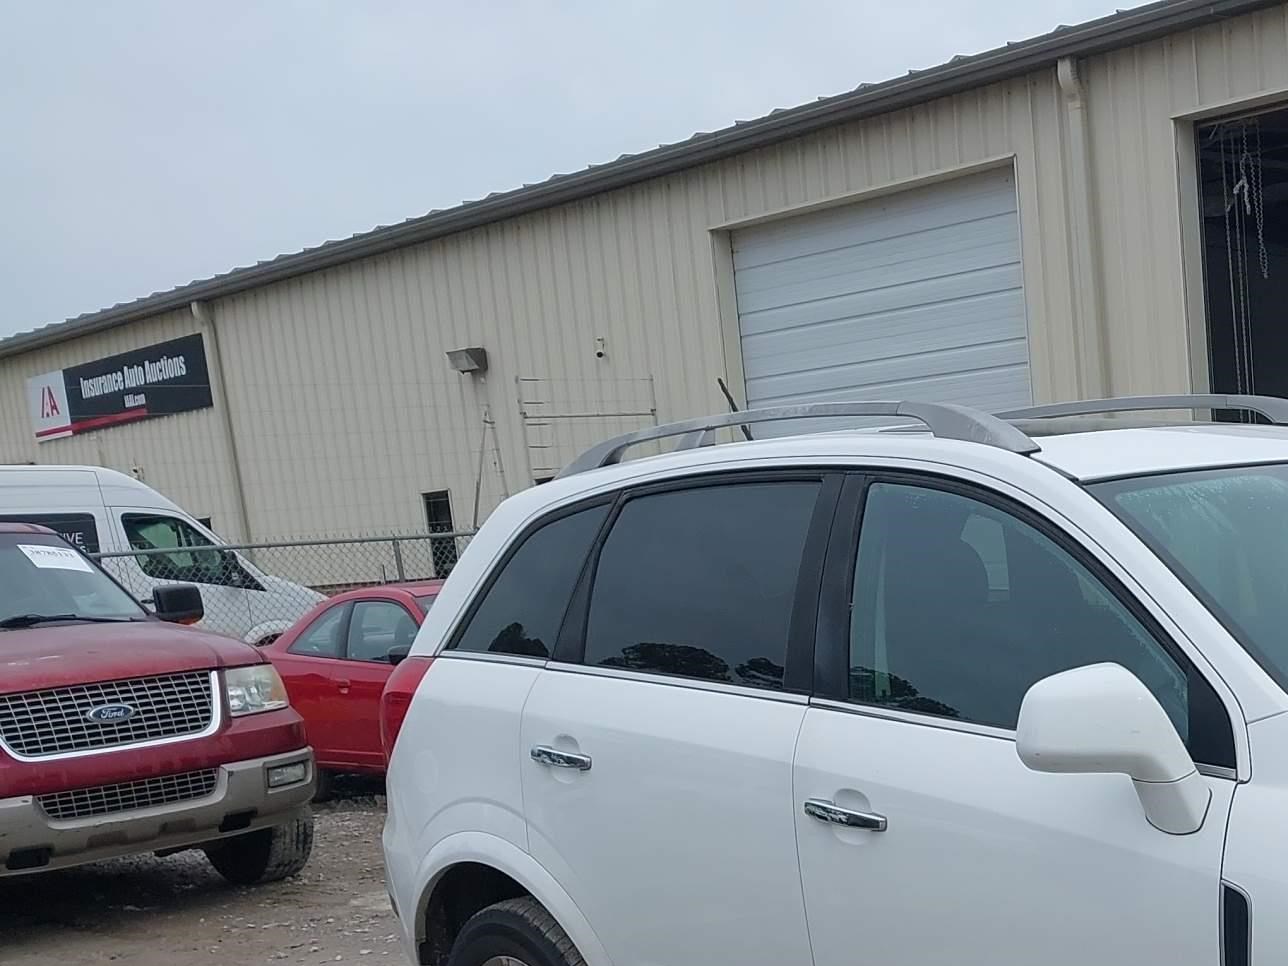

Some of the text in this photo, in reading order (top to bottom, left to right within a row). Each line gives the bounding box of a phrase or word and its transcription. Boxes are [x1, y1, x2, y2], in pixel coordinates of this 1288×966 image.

[80, 355, 187, 399] Insurance Auto Auctions
[100, 707, 124, 718] Ford
